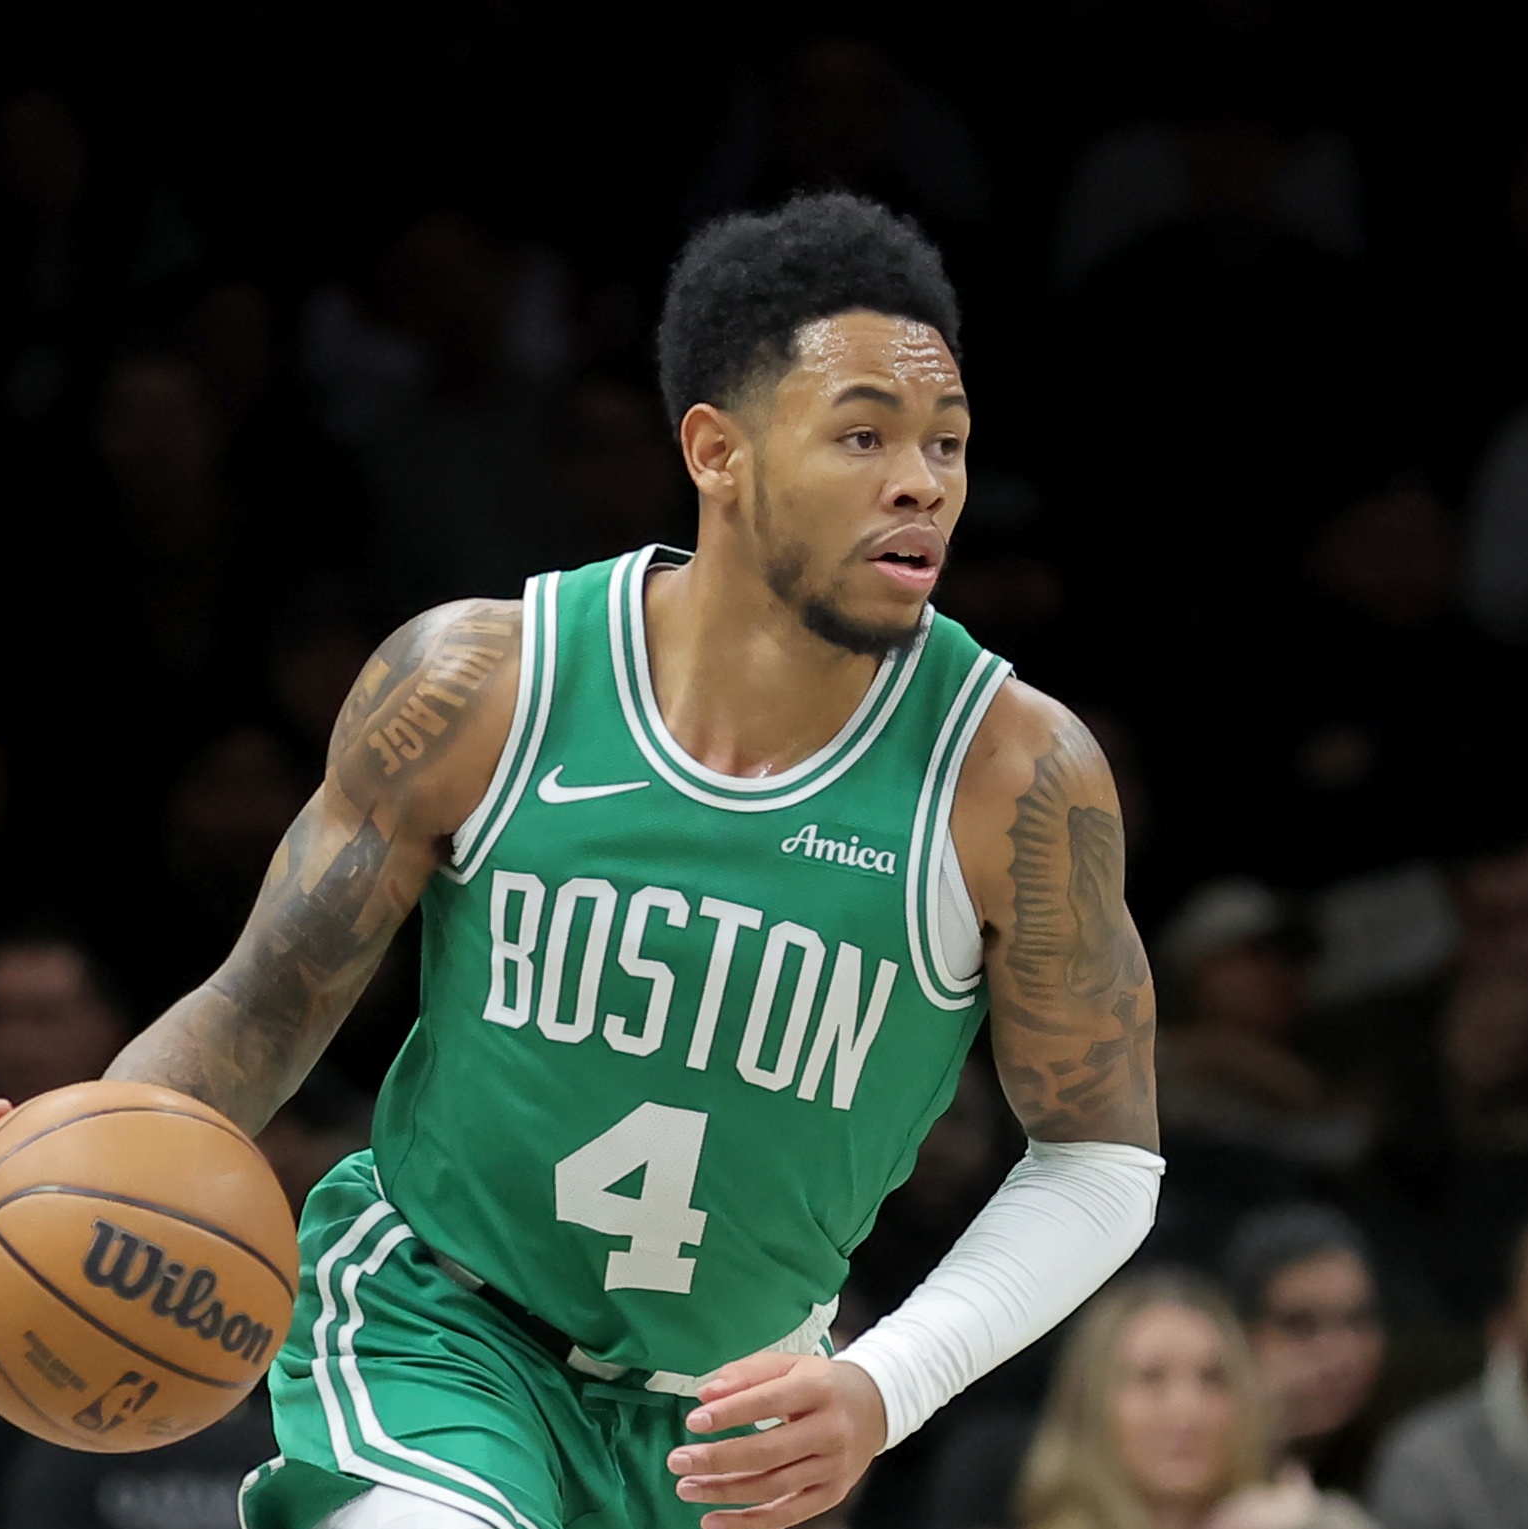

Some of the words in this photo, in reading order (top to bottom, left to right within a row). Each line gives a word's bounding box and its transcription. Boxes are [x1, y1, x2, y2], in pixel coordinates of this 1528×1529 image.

[780, 823, 898, 875] Amica
[482, 869, 899, 1111] BOSTON
[554, 1101, 709, 1295] 4
[83, 1216, 274, 1366] Wilson
